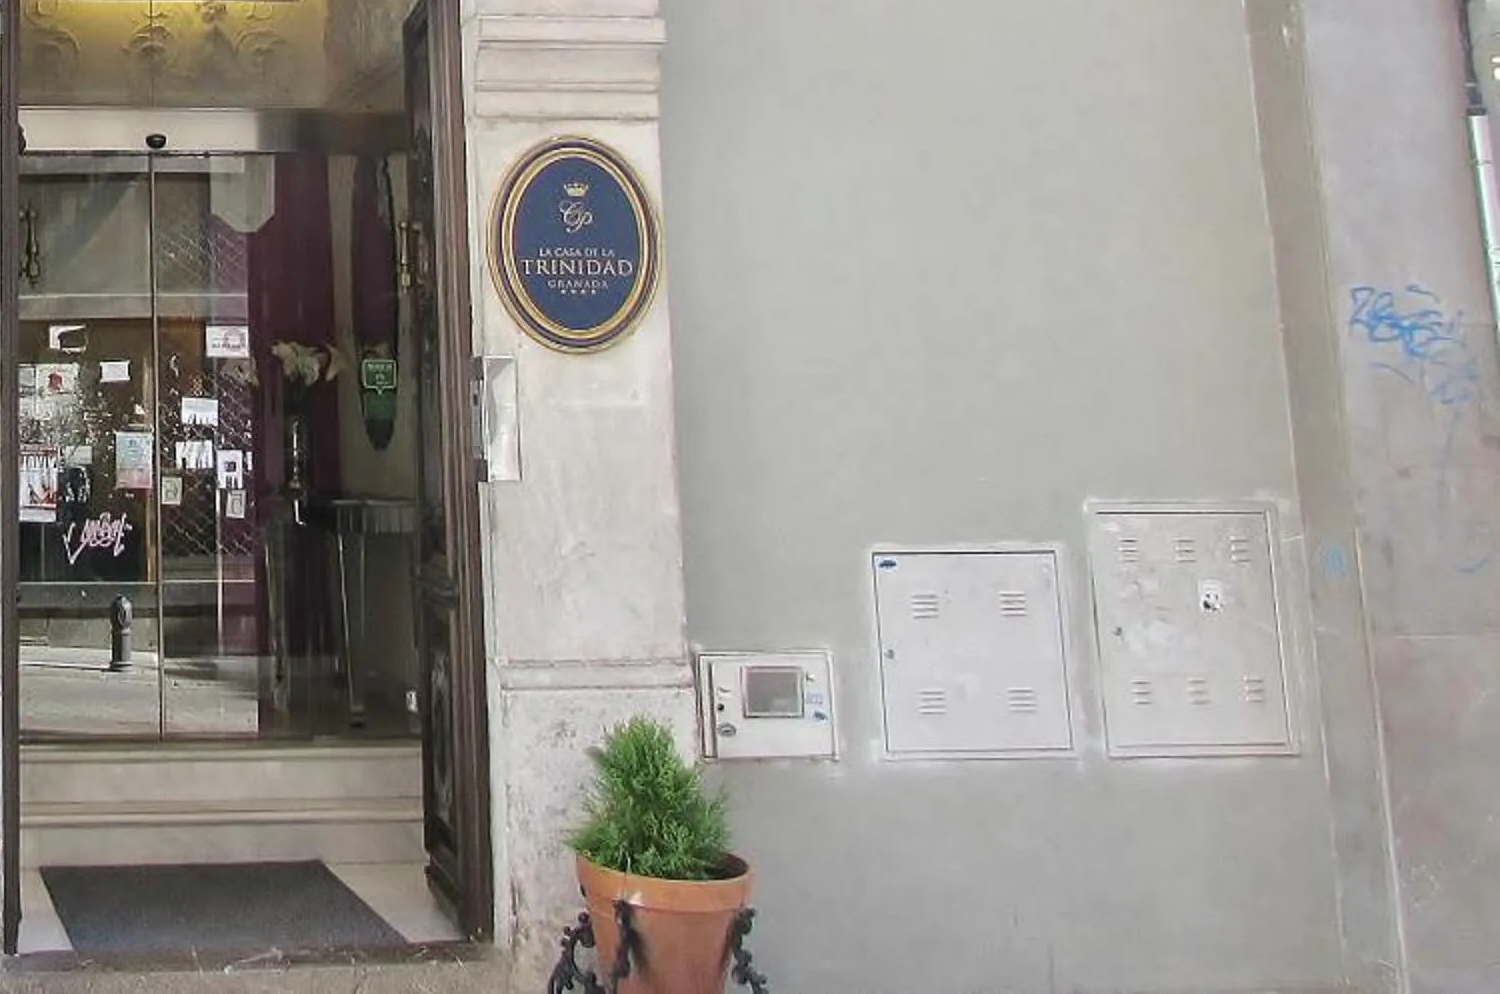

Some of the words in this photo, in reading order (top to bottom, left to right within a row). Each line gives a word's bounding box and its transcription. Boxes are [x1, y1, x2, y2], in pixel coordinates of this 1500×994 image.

[538, 247, 553, 257] LA
[554, 247, 581, 257] CASA
[601, 247, 616, 257] LA
[520, 259, 633, 276] TRINIDAD
[547, 278, 609, 289] GRANADA
